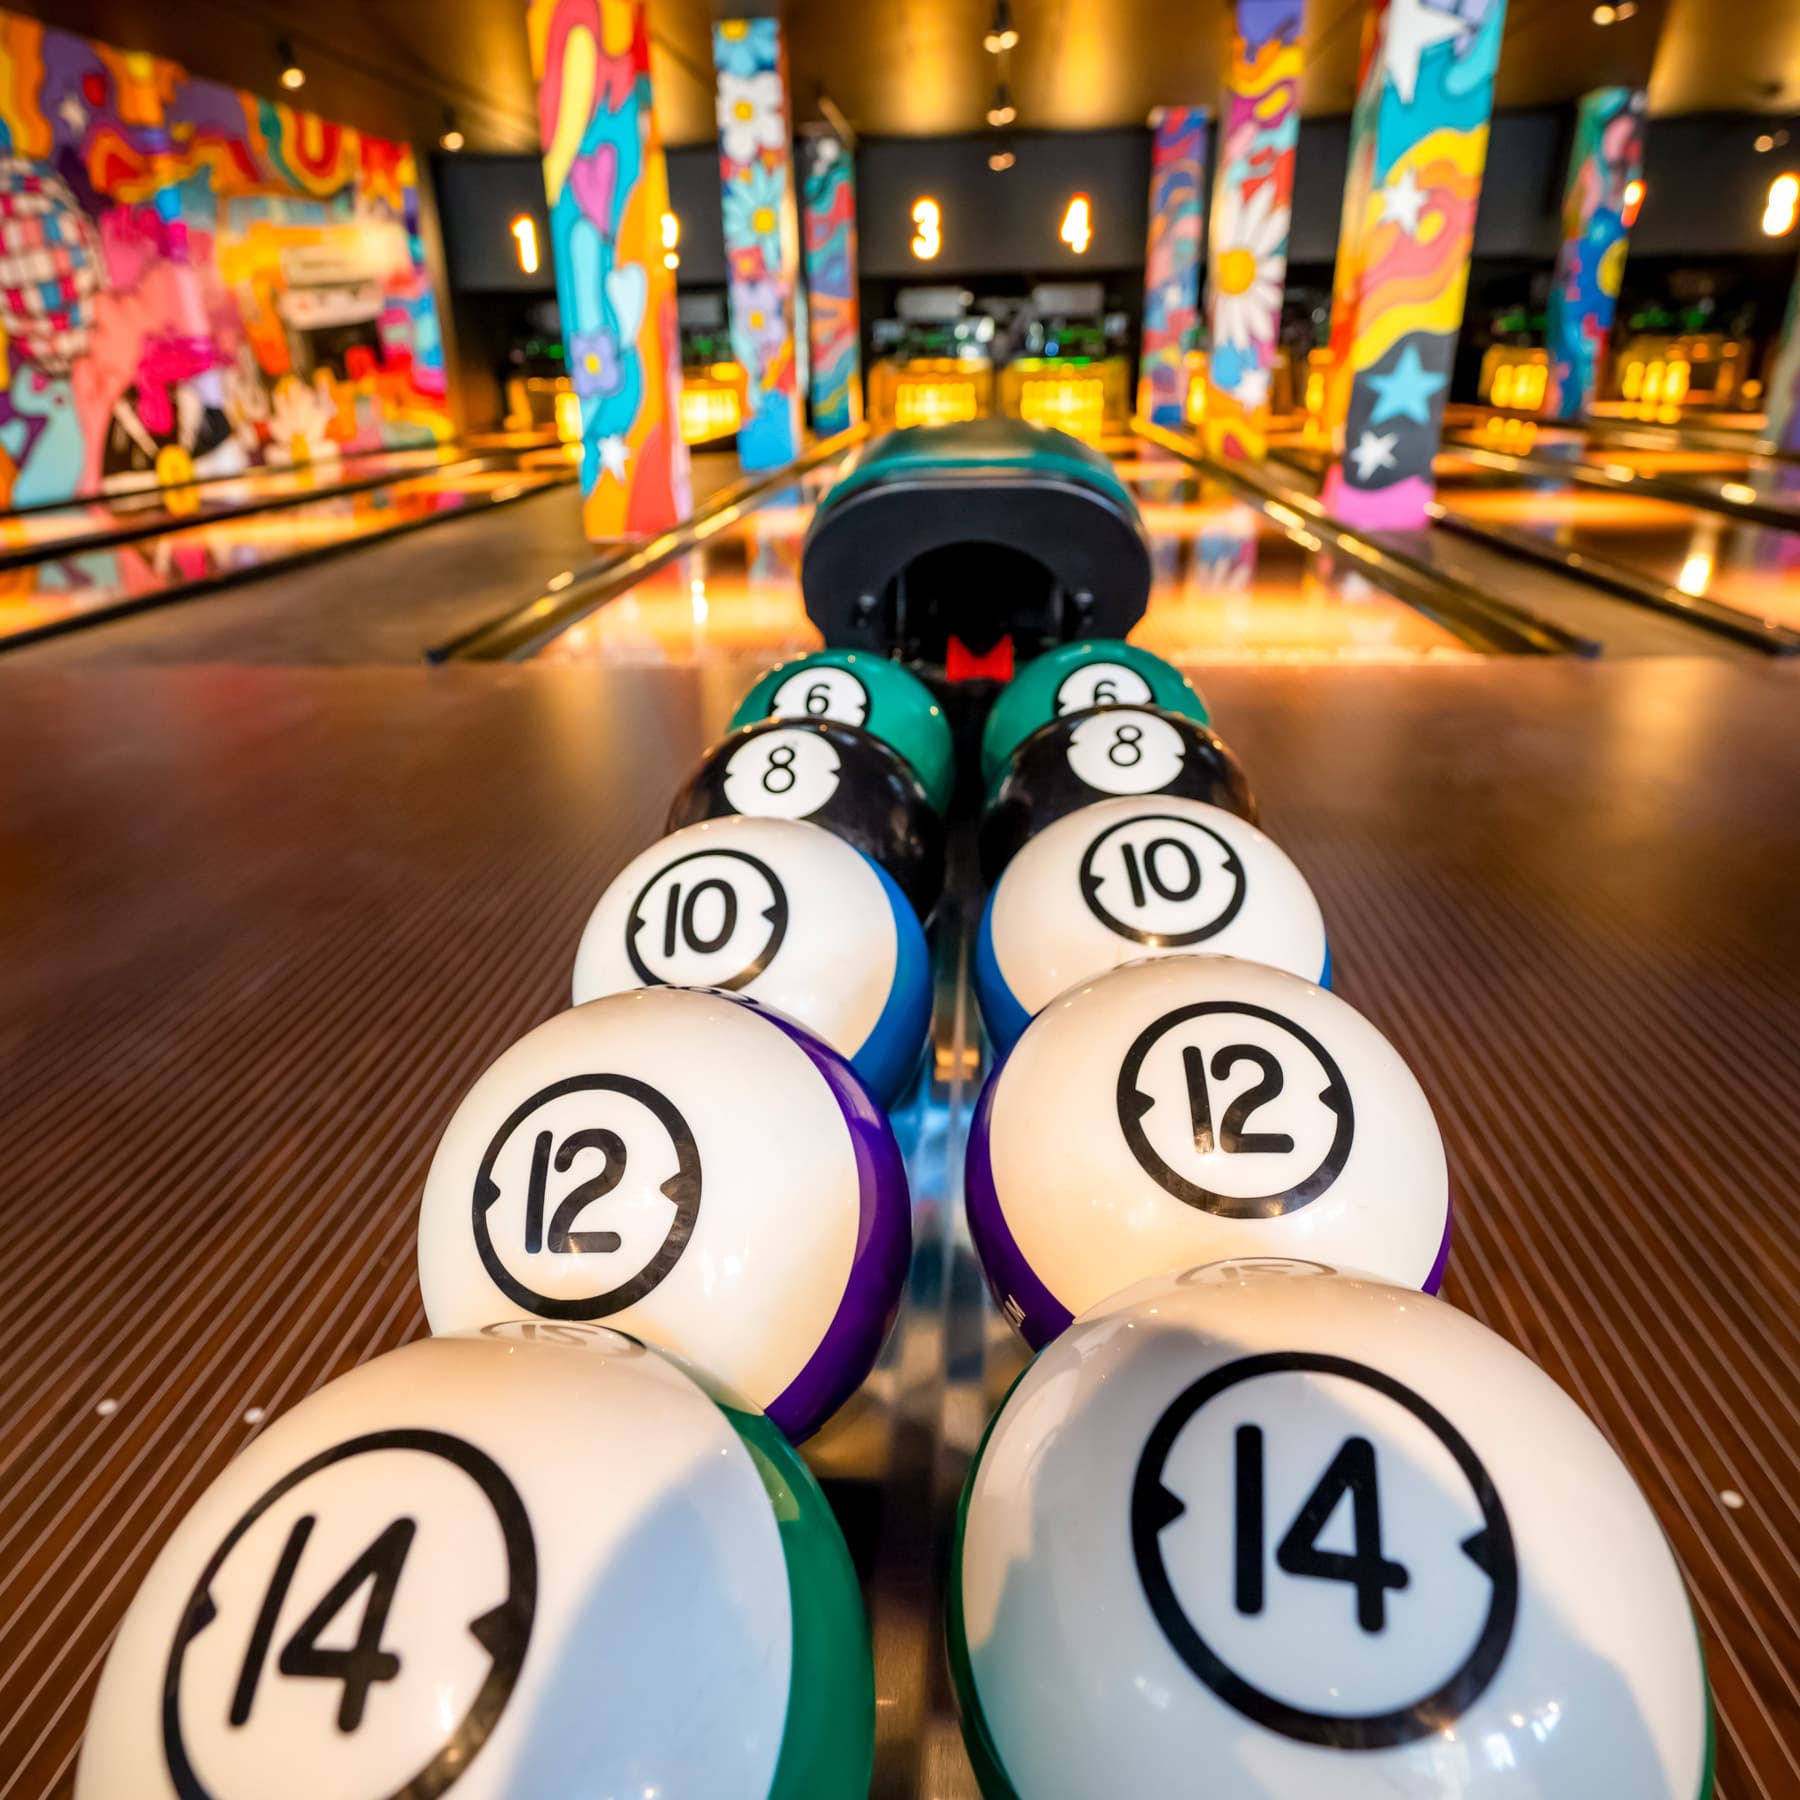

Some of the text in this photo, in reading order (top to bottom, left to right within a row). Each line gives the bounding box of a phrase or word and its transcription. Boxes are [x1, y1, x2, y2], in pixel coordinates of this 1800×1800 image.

[510, 213, 539, 274] 1
[911, 195, 942, 260] 3
[1059, 191, 1094, 254] 4
[806, 684, 830, 718] 6
[1094, 681, 1119, 706] 6
[763, 746, 795, 793] 8
[1109, 725, 1142, 767] 8
[1121, 838, 1200, 907] 10
[664, 879, 737, 957] 10
[1182, 1043, 1295, 1154] 12
[525, 1129, 627, 1254] 12
[1233, 1421, 1411, 1637] 14
[228, 1514, 417, 1734] 14
